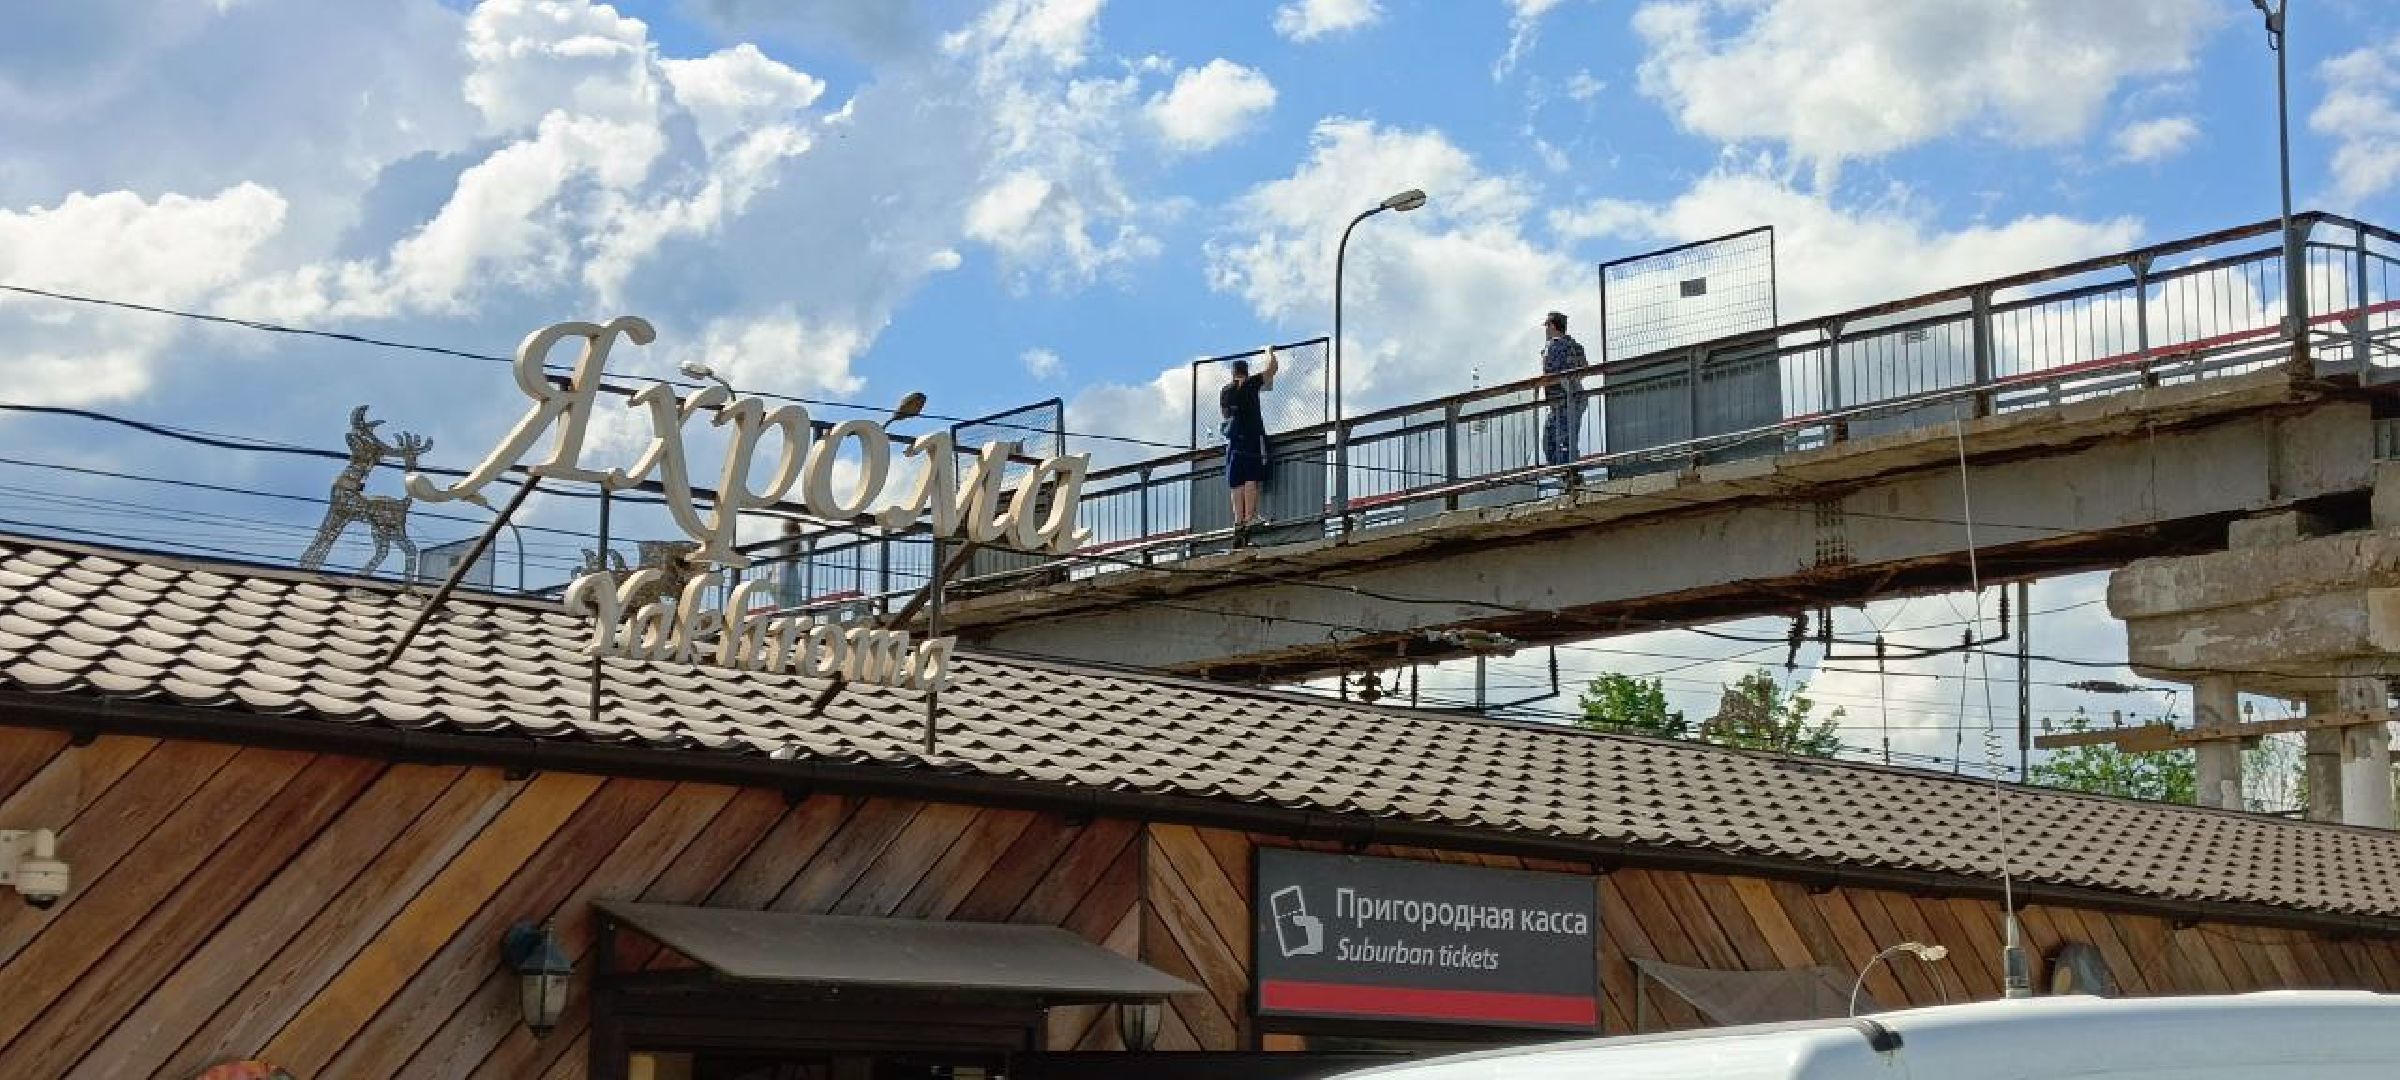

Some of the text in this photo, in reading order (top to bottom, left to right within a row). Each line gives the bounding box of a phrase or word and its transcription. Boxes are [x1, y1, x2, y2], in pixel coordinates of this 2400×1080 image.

[405, 315, 1092, 568] Яхрома
[564, 568, 957, 691] Yakhroma
[1336, 887, 1588, 935] Пригородная касса
[1337, 937, 1499, 970] Suburban tickets
